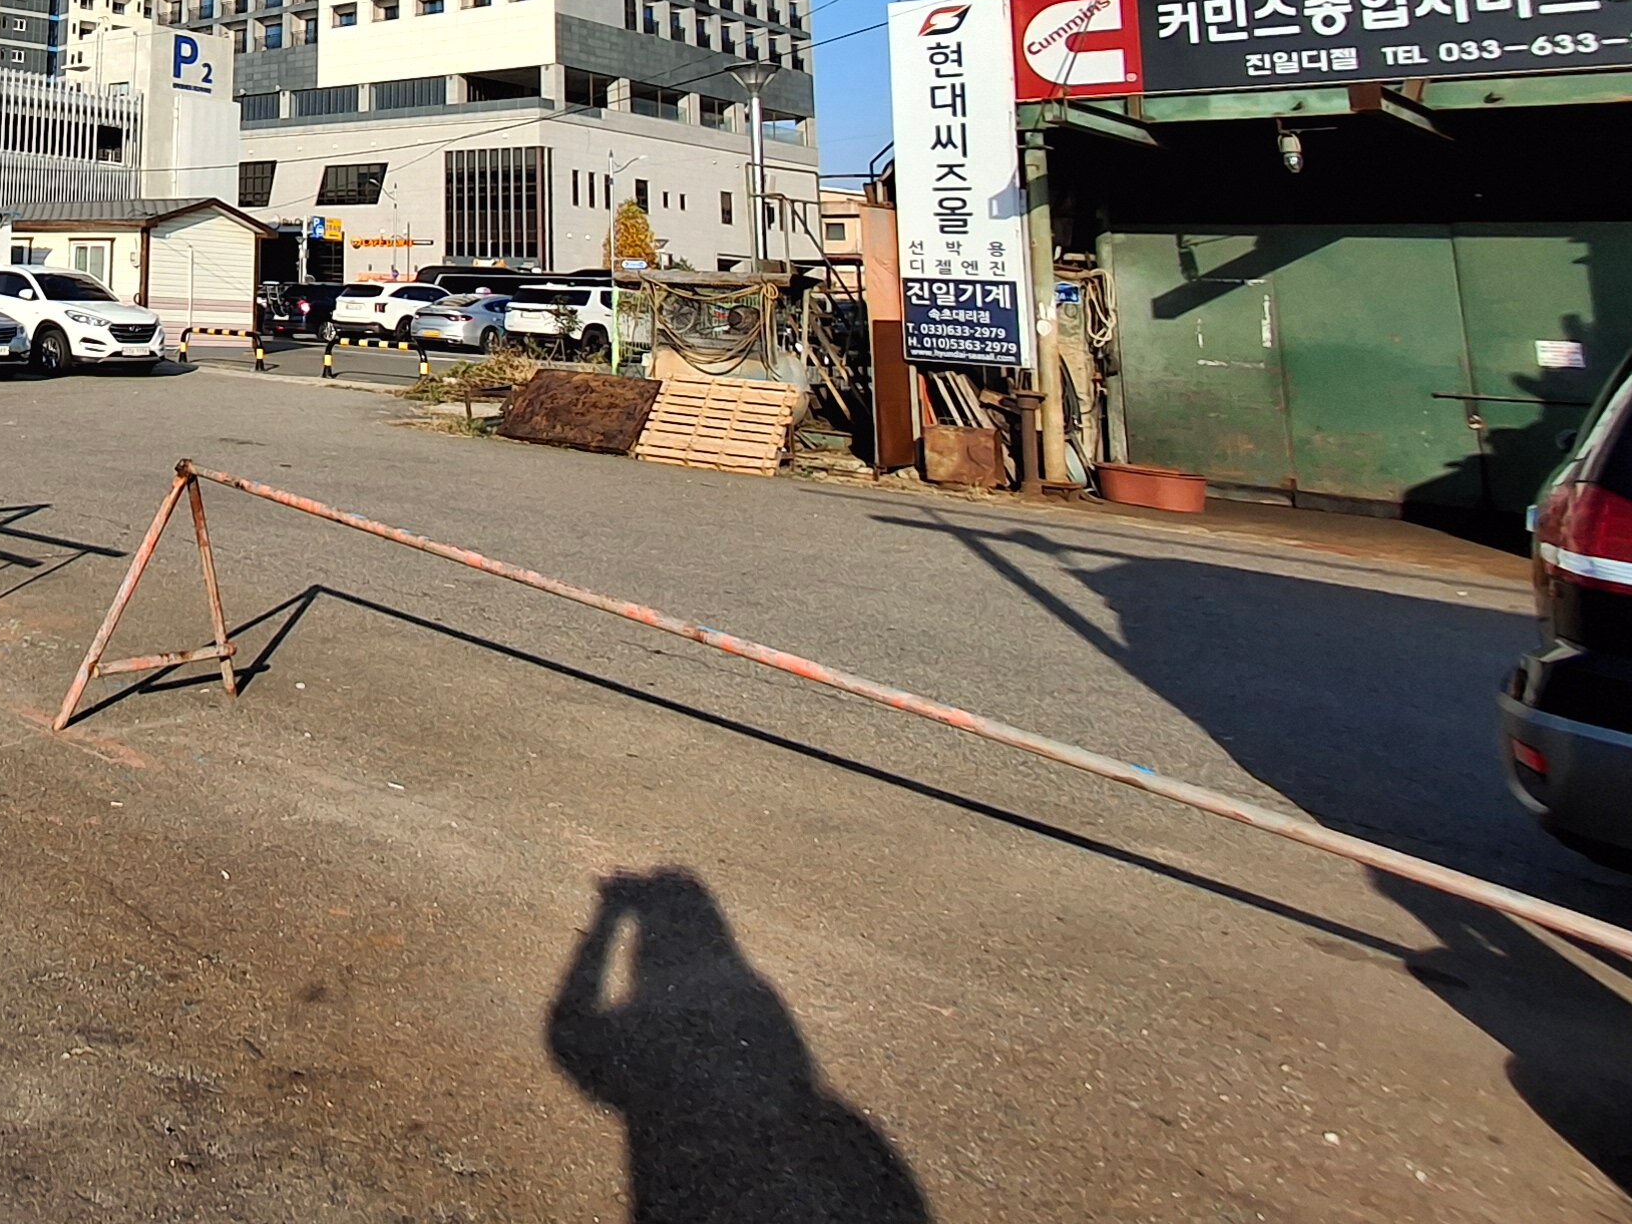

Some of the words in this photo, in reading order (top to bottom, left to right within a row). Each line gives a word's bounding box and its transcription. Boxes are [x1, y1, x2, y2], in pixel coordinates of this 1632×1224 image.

[1244, 47, 1359, 77] 진일디젤
[1380, 45, 1429, 66] TEL
[1438, 32, 1632, 63] 033-633-
[926, 41, 974, 235] 현대씨즈올
[906, 281, 1011, 309] 진일기계
[928, 308, 991, 324] 속초대리점
[920, 323, 1006, 339] 033)633-2979
[923, 337, 1017, 354] 010)5363-2979
